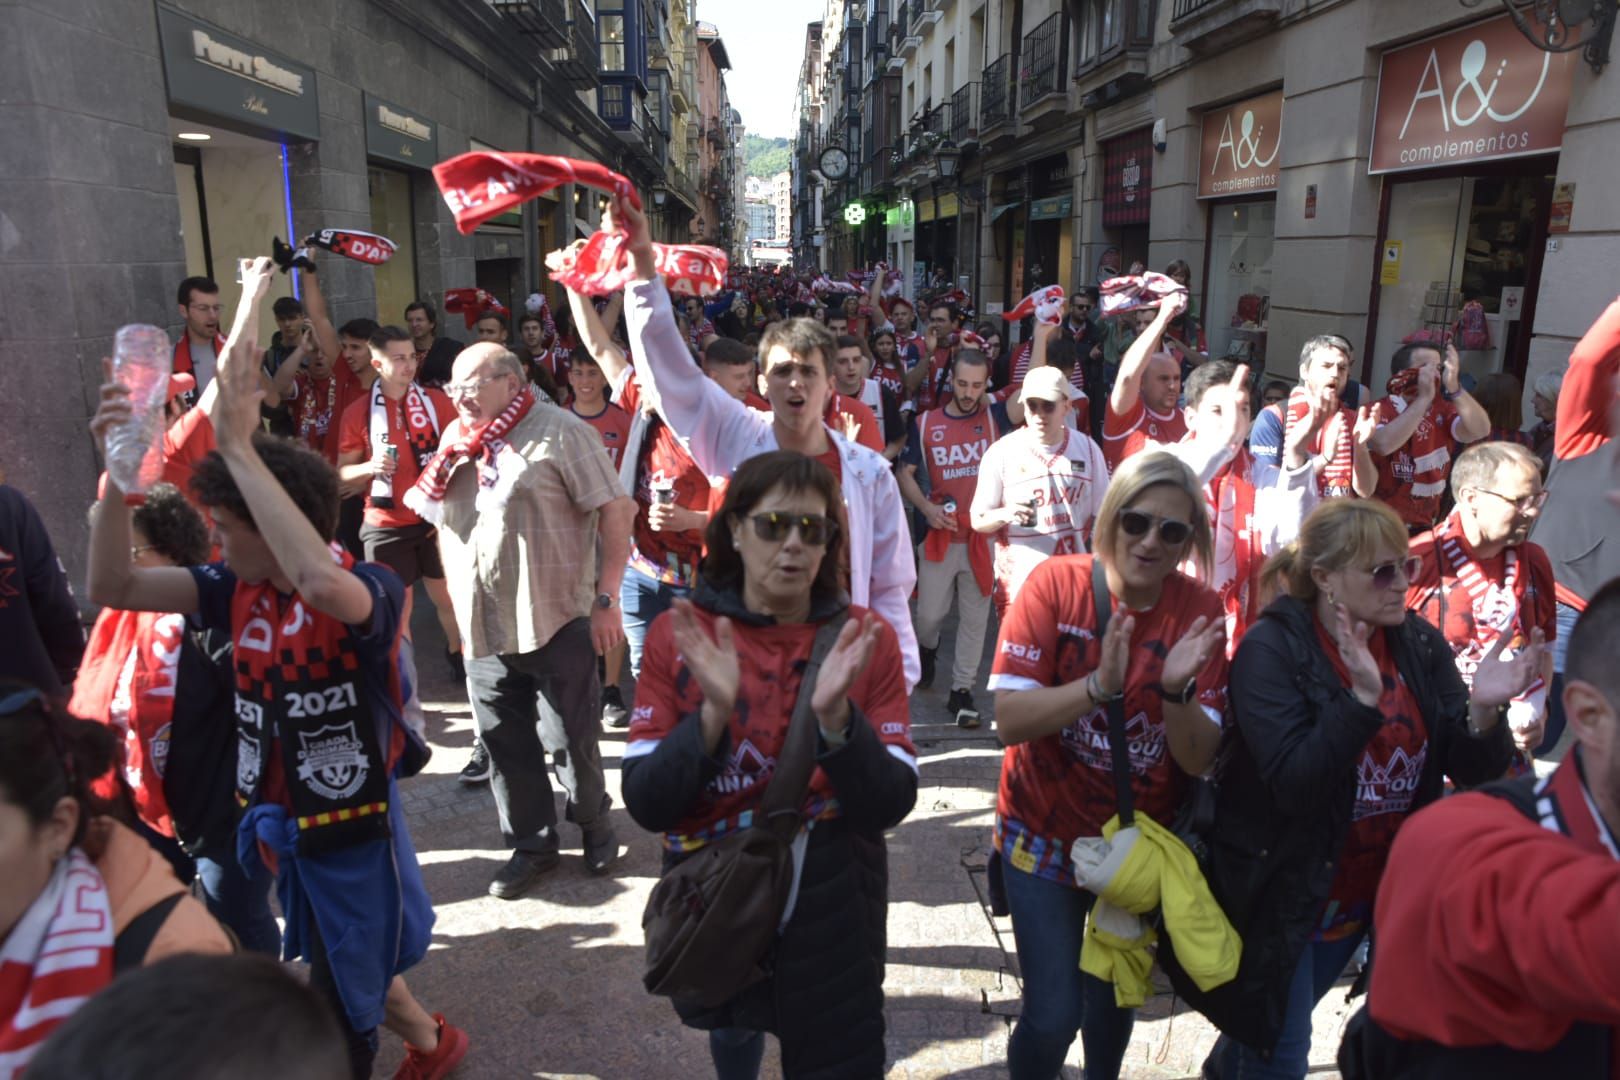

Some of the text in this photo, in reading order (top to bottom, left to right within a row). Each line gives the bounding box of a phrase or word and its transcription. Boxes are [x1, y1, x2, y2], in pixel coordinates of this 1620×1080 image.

[1400, 130, 1529, 164] complementos
[1212, 173, 1276, 193] complementos
[284, 682, 358, 718] 2021
